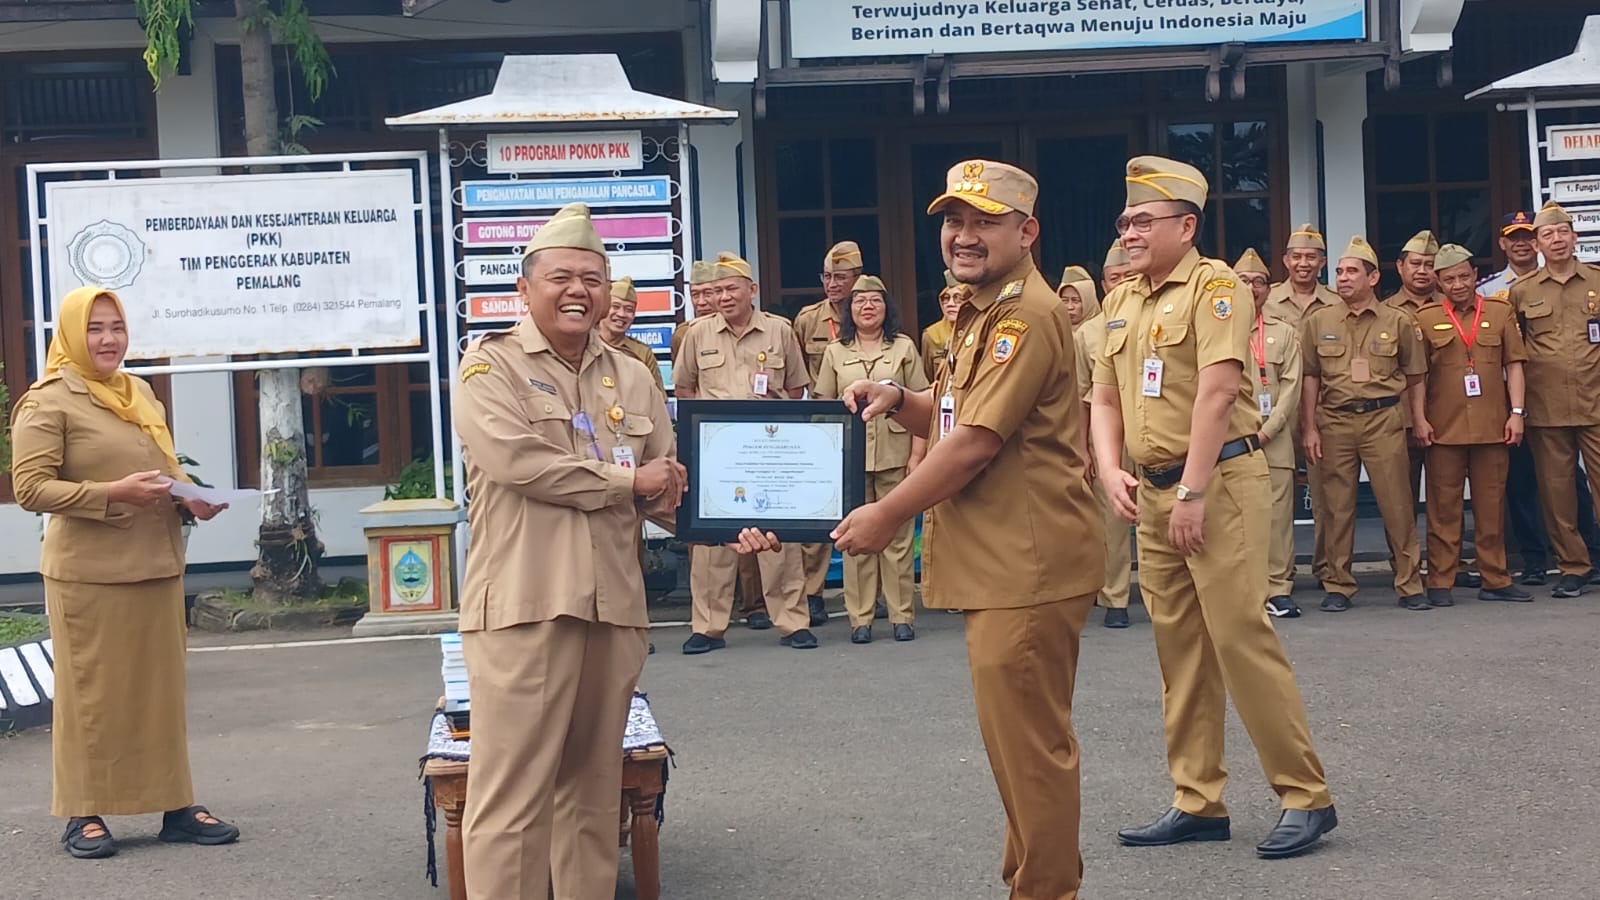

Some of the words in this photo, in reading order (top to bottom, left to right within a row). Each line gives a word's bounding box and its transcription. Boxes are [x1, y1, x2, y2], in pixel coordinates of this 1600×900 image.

[852, 1, 979, 20] Terwujudnya
[985, 0, 1071, 15] Keluarga
[1077, 0, 1137, 10] Sehat,
[851, 26, 934, 40] Beriman
[940, 23, 975, 38] dan
[982, 20, 1075, 37] Bertaqwa
[1081, 16, 1154, 33] Menuju
[1160, 12, 1254, 29] Indonesia
[1260, 10, 1307, 28] Maju
[499, 146, 511, 161] 10
[514, 144, 566, 161] PROGRAM
[569, 143, 606, 160] POKOK
[609, 142, 630, 159] PKK
[537, 187, 554, 200] DAN
[611, 184, 656, 198] PANCASILA
[1575, 182, 1600, 193] Fungsi
[145, 215, 228, 232] PEMBERDAYAAN
[231, 214, 253, 229] DAN
[255, 211, 341, 228] KESEJAHTERAAN
[344, 208, 397, 224] KELUARGA
[478, 225, 515, 239] GOTONG
[246, 232, 282, 249] (PKK)
[1580, 244, 1600, 254] Fung
[180, 257, 202, 271] TIM
[205, 253, 278, 270] PENGGERAK
[281, 251, 351, 267] KABUPATEN
[480, 263, 519, 276] PANGAN
[236, 274, 302, 290] PEMALANG
[358, 298, 402, 310] Pemalang
